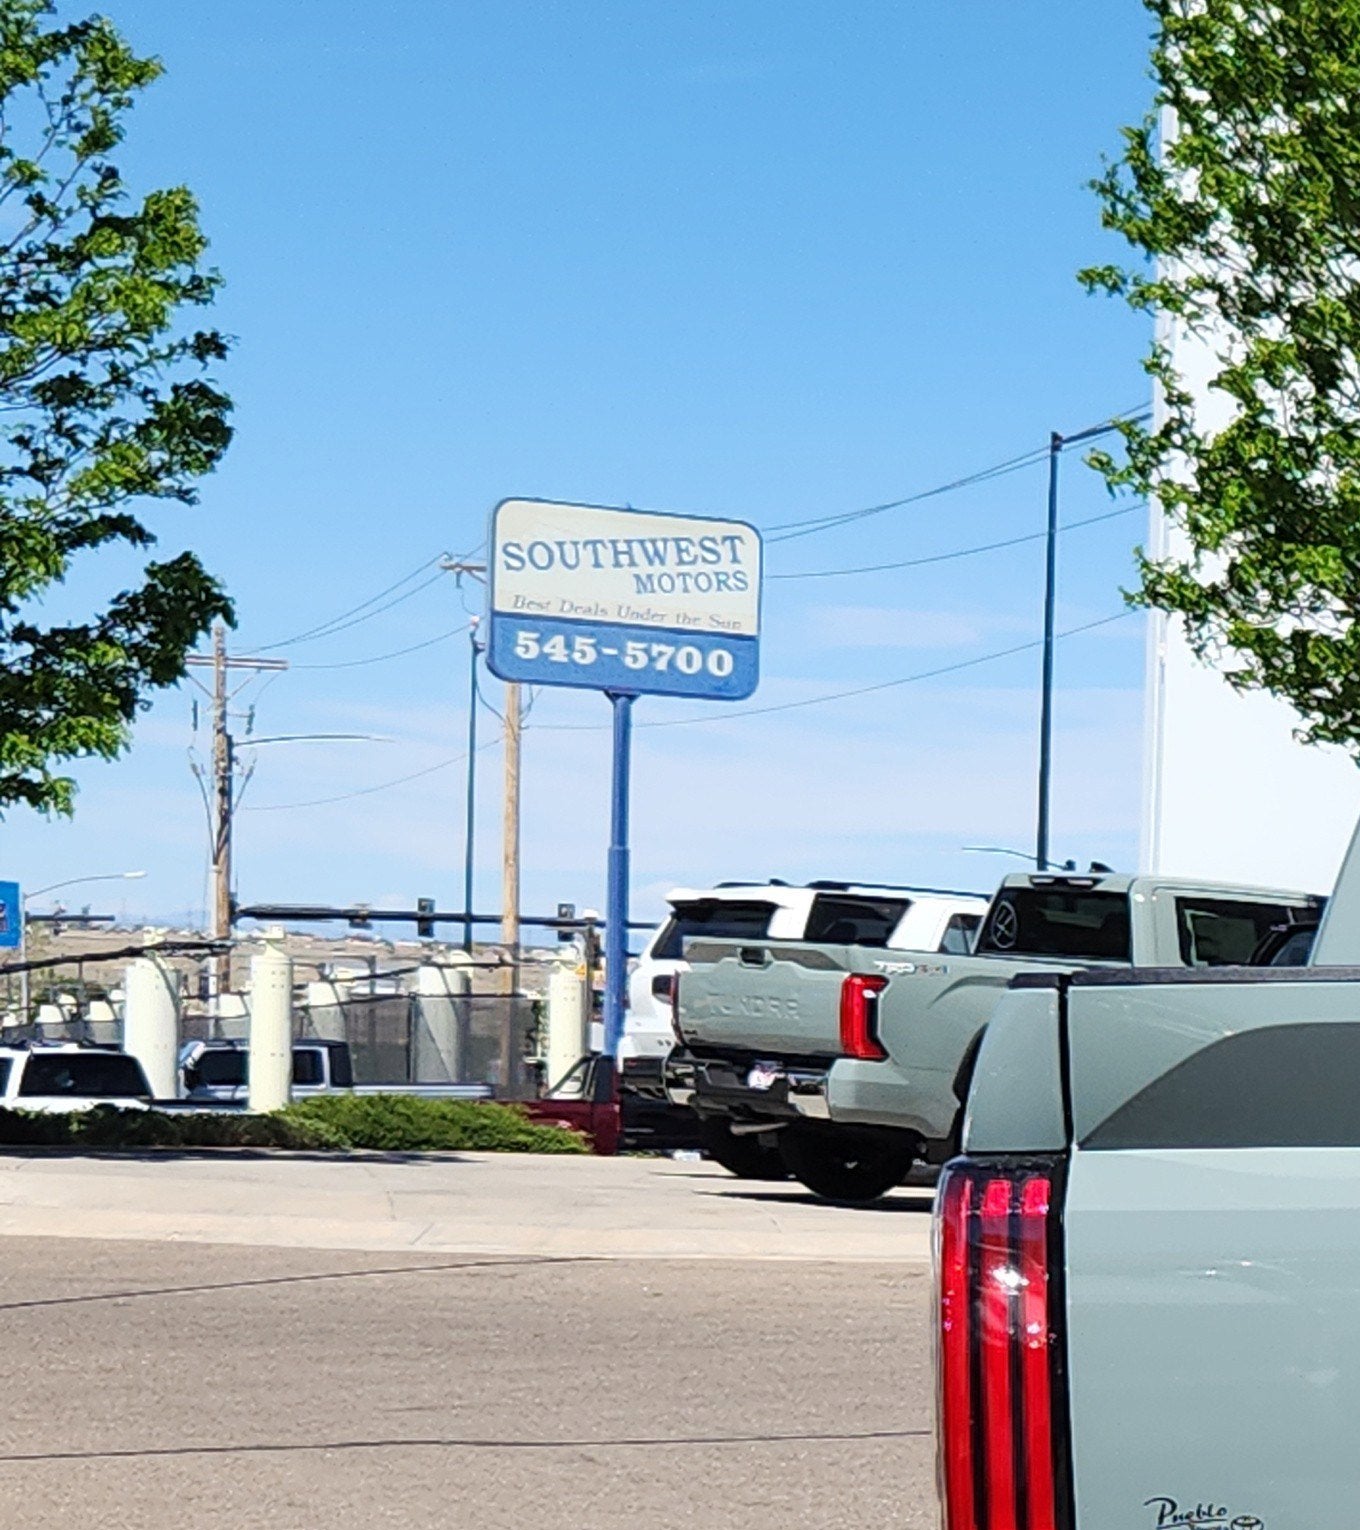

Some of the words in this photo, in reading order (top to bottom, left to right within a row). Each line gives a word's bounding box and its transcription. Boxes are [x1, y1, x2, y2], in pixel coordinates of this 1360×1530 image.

[503, 534, 747, 571] SOUTHWEST
[632, 570, 749, 595] MOTORS
[512, 594, 551, 611] Best
[559, 599, 609, 617] Deals
[616, 604, 669, 623] Under
[675, 609, 702, 626] the
[708, 614, 742, 631] Sun
[514, 631, 735, 678] 545-5700
[1143, 1496, 1228, 1526] Pueblo
